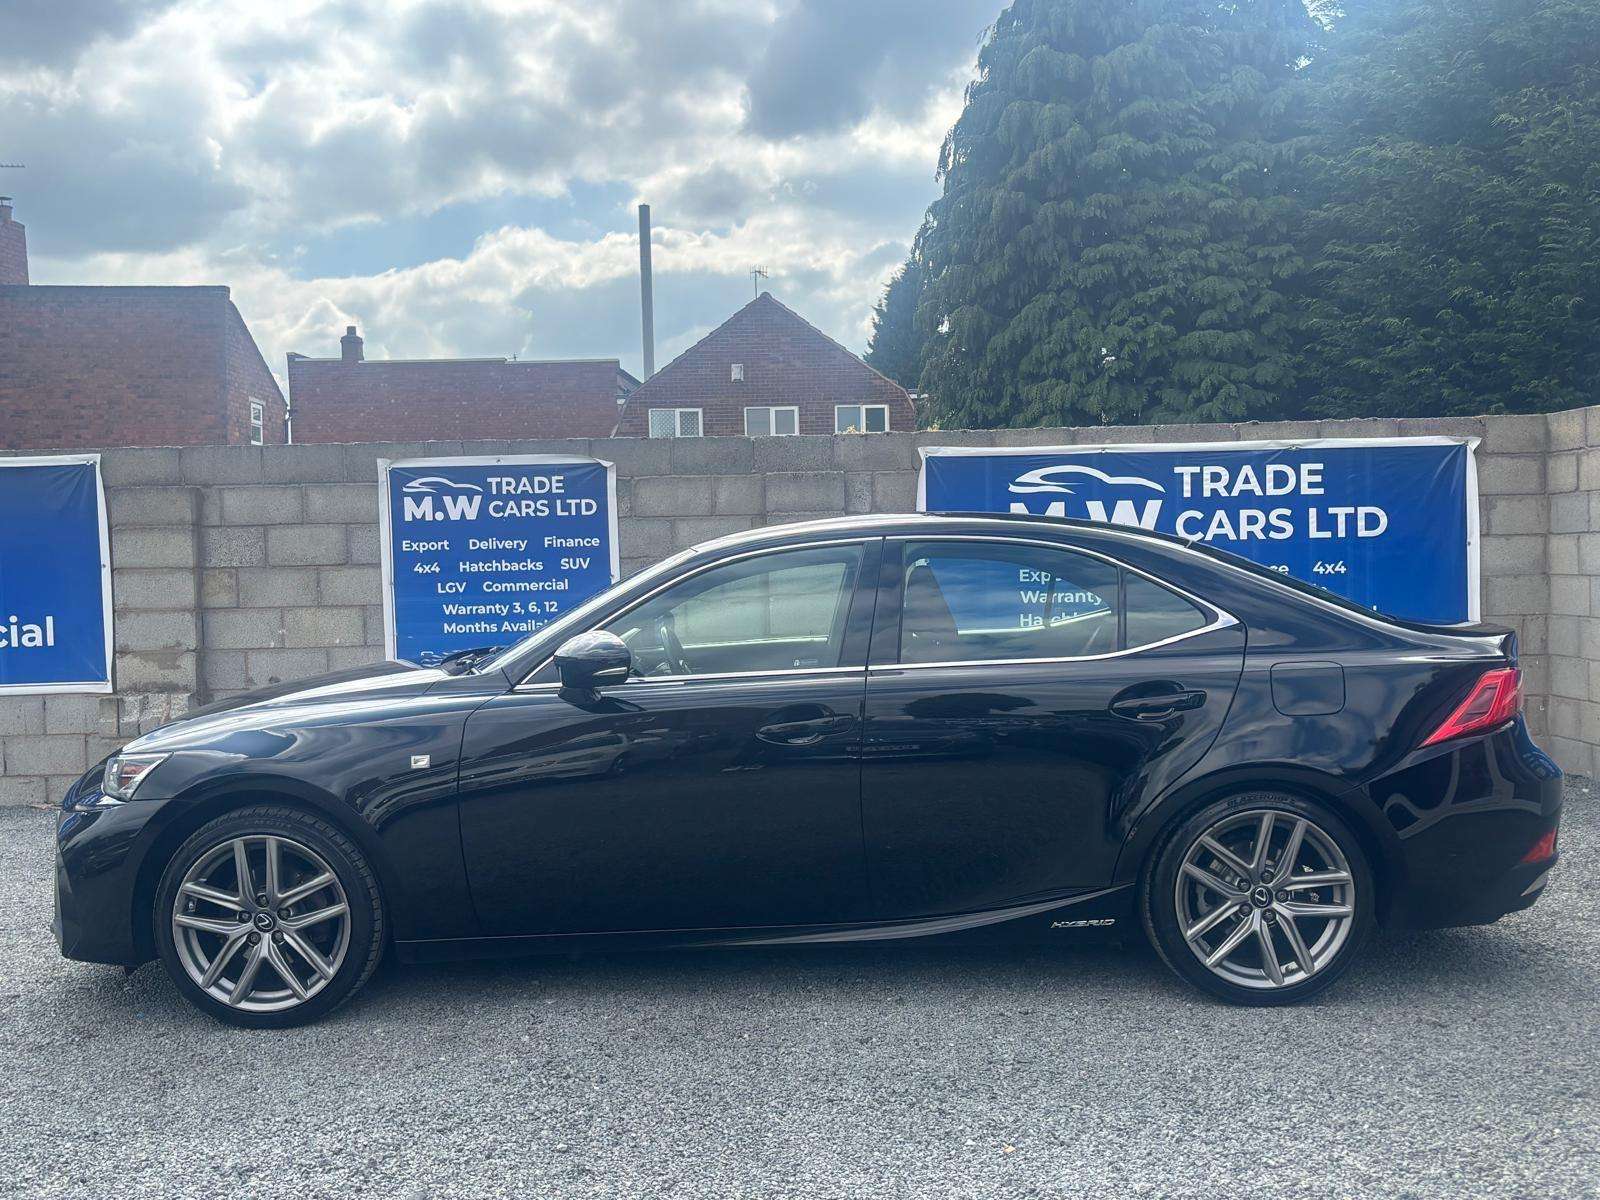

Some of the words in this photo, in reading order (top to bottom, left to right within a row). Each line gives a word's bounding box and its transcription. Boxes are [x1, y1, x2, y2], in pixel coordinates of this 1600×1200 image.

[487, 476, 565, 494] TRADE
[1174, 464, 1325, 499] TRADE
[403, 495, 482, 522] M.W
[488, 500, 550, 518] CARS
[556, 499, 598, 516] LTD
[1175, 506, 1294, 543] CARS
[1308, 506, 1389, 538] LTD
[402, 540, 450, 554] Export
[469, 538, 528, 552] Delivery
[544, 536, 600, 549] Finance
[413, 562, 441, 574] 4x4
[459, 559, 544, 573] Hatchbacks
[560, 558, 590, 570] SUV
[1312, 560, 1347, 575] 4x4
[437, 582, 466, 594] LGV
[482, 578, 569, 593] Commercial
[443, 603, 509, 617] Warranty
[513, 602, 525, 616] 3,
[528, 601, 541, 615] 6,
[544, 601, 558, 613] 12
[443, 622, 498, 634] Months
[1050, 918, 1116, 929] HYBRID
